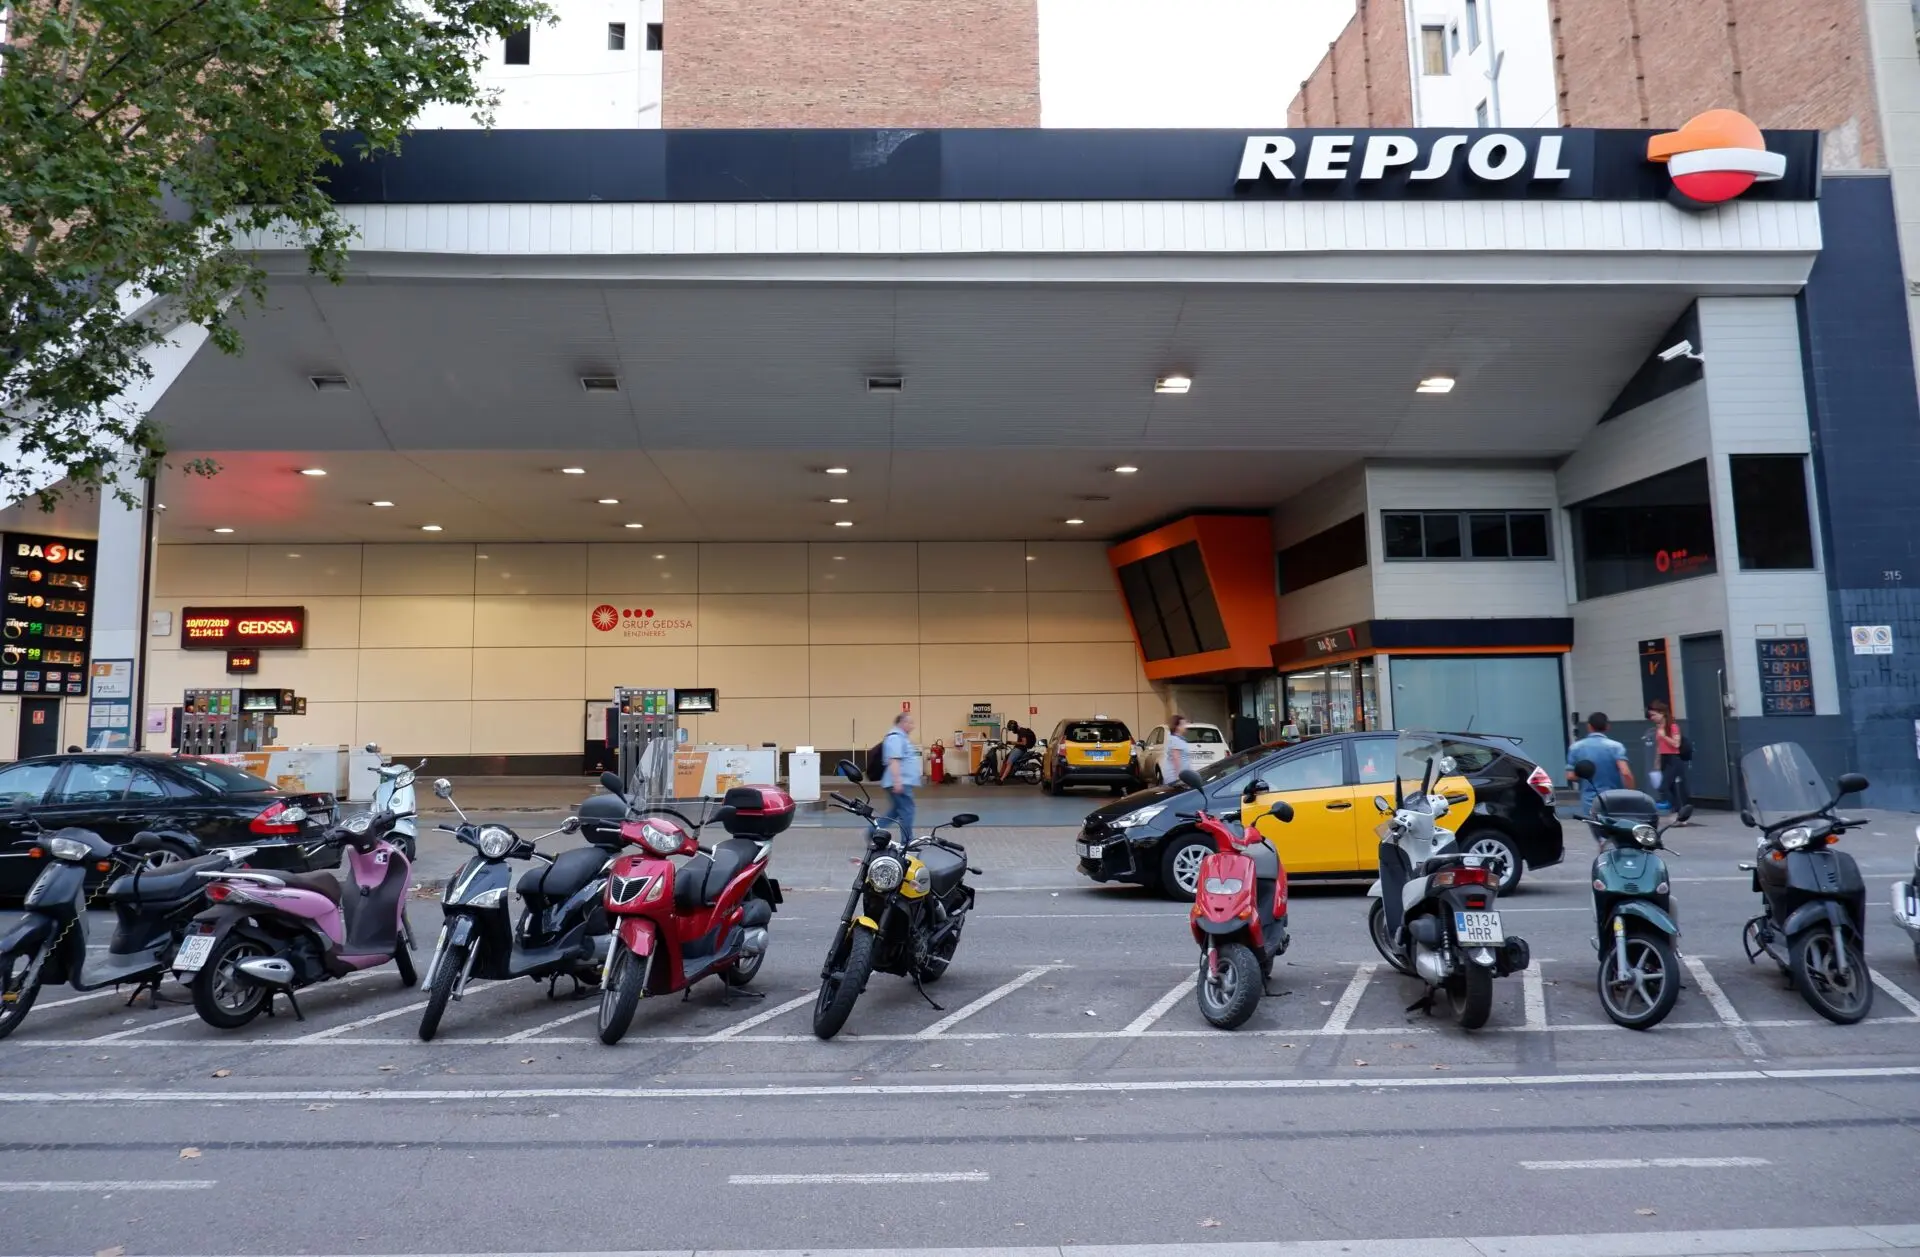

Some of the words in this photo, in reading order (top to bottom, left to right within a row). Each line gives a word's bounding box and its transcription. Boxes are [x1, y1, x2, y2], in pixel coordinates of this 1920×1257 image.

[1238, 134, 1572, 181] REPSOL
[18, 544, 85, 563] BASIC
[1882, 570, 1902, 581] 315
[7, 594, 27, 602] Diesel
[30, 622, 43, 631] 95
[186, 619, 229, 628] 10/07/2019
[238, 621, 294, 634] GEDSSA
[622, 620, 649, 629] GRUP
[653, 620, 693, 629] GEDSSA
[190, 628, 224, 637] 21:14:11
[28, 648, 41, 657] 98
[1090, 847, 1101, 857] SP
[1466, 914, 1498, 927] 8134
[1468, 927, 1493, 941] HRR
